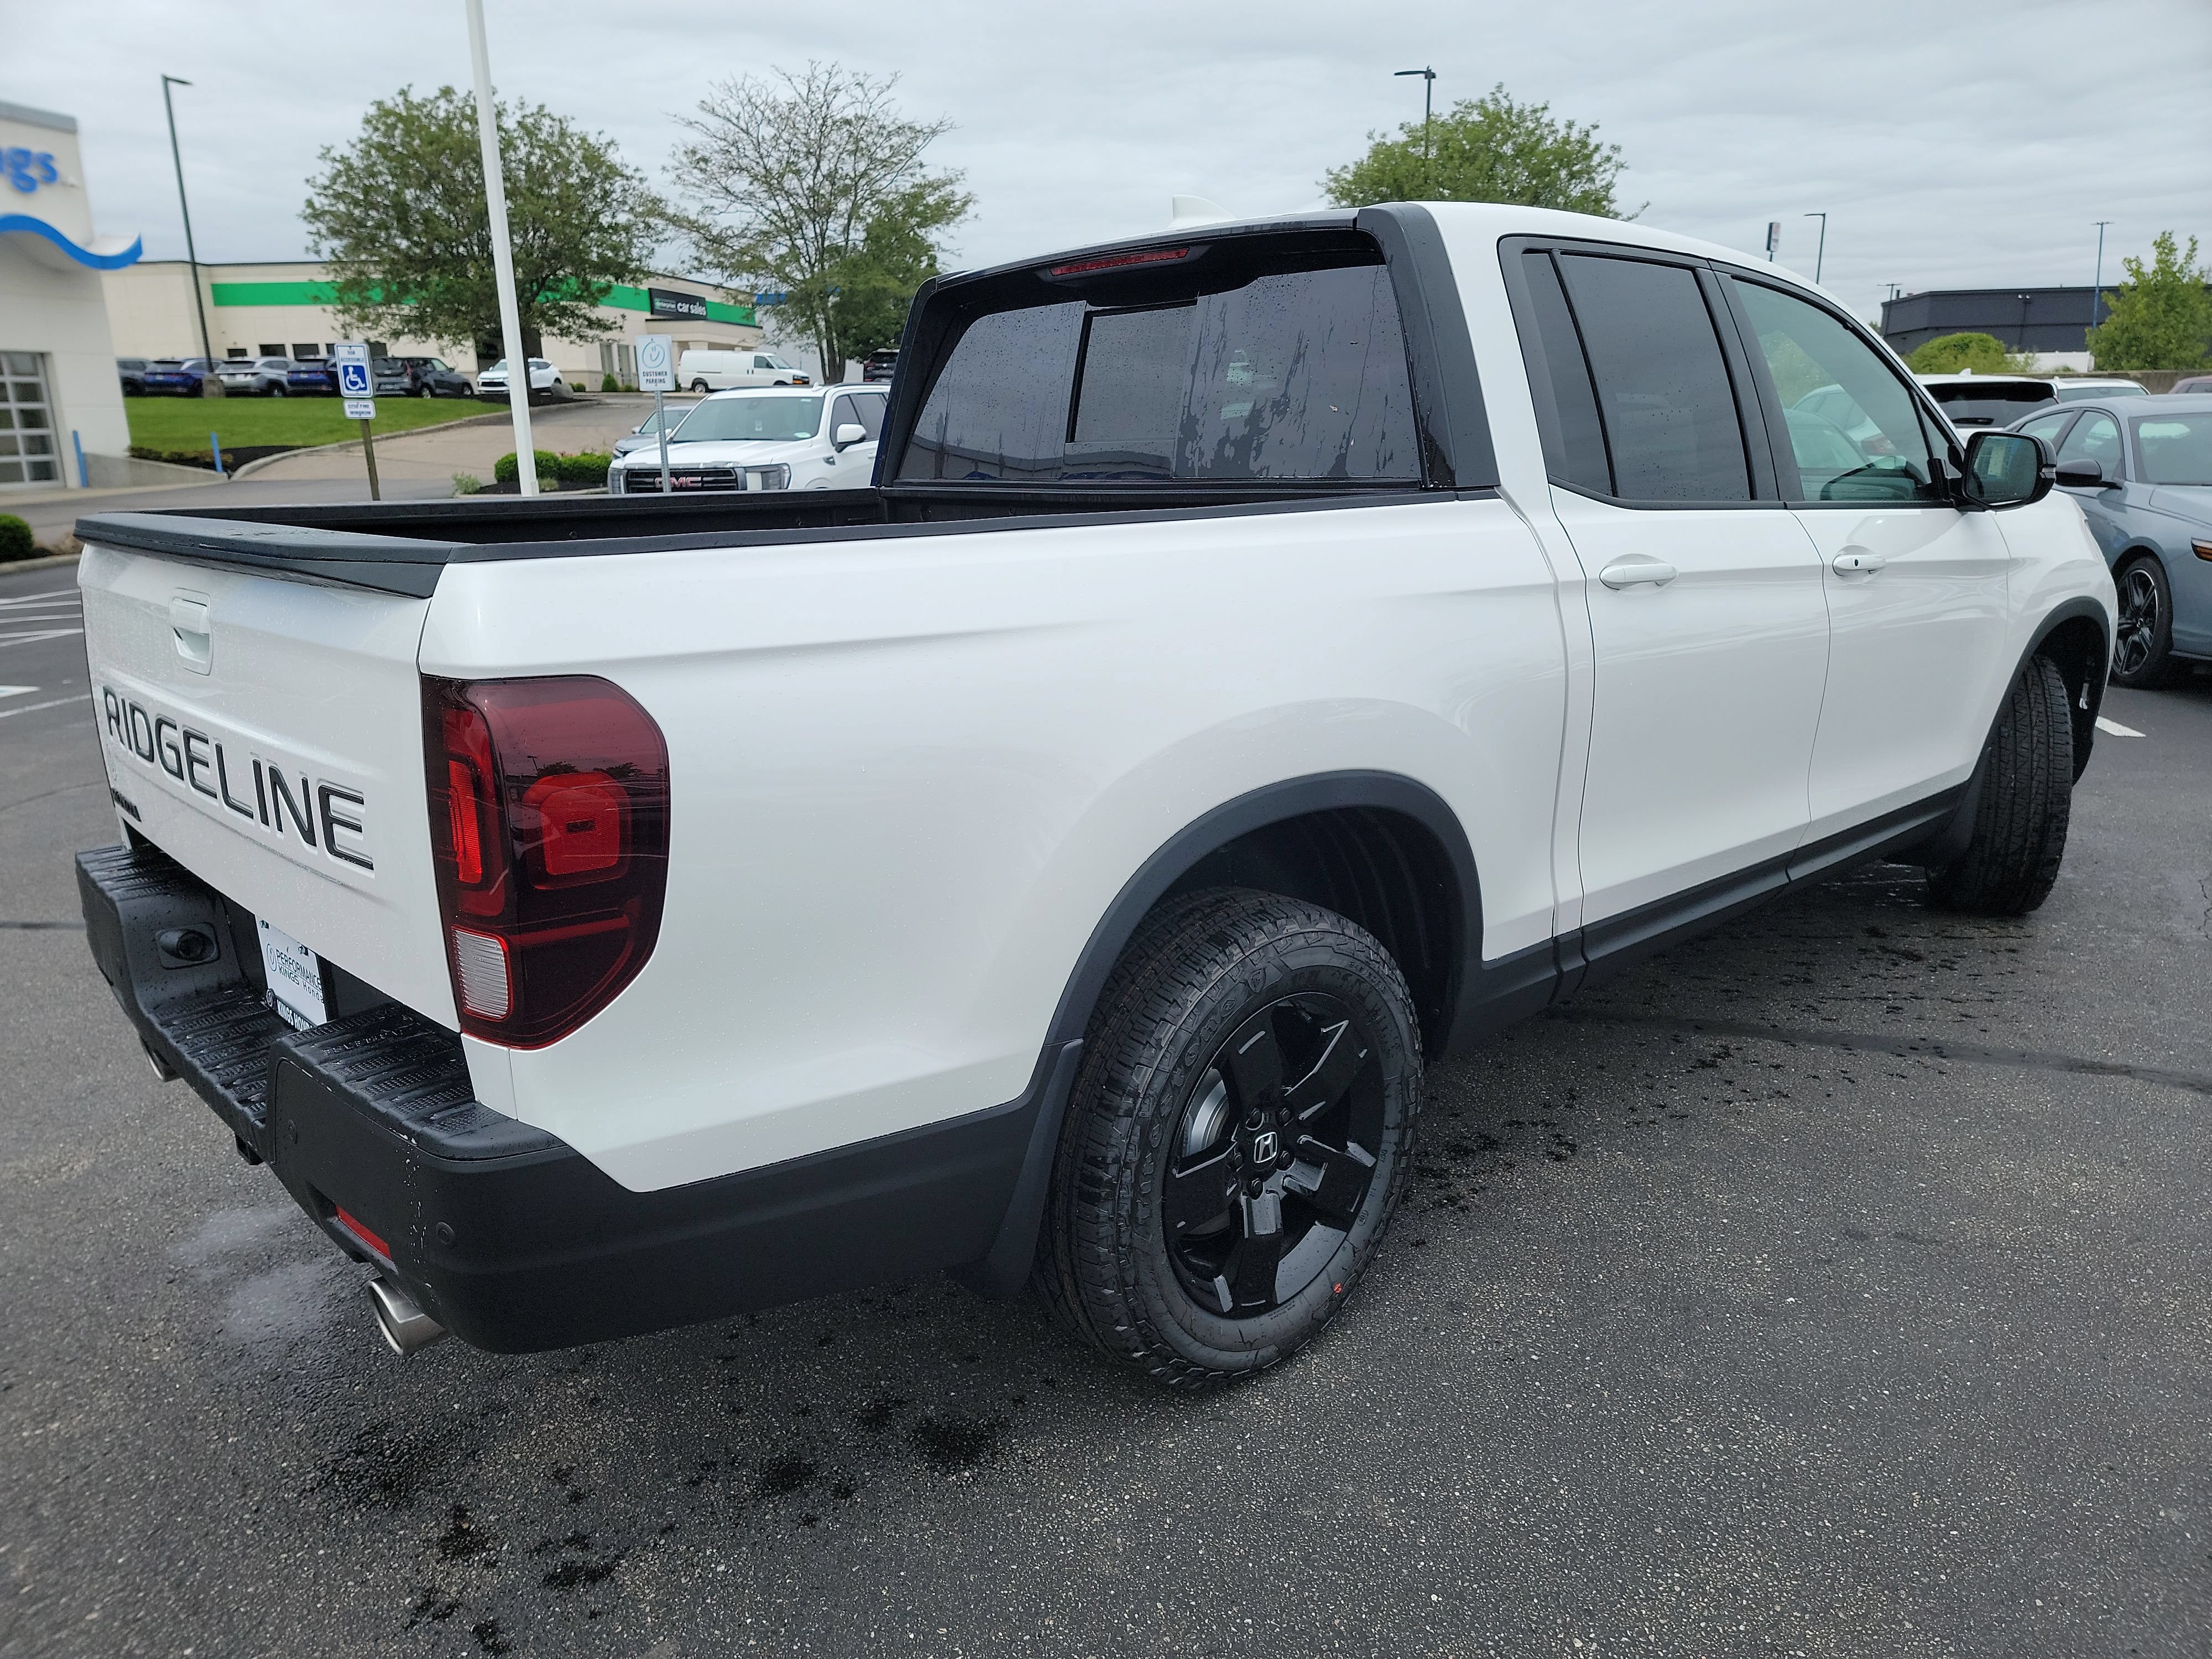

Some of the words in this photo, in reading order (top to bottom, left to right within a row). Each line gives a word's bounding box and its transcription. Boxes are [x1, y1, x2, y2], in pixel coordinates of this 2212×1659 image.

[0, 147, 58, 193] gs
[103, 685, 374, 870] RIDGELINE
[276, 948, 322, 991] PERFORMANCE
[278, 964, 300, 985] KINGS
[302, 980, 325, 1004] Honda
[276, 999, 294, 1026] KINGS
[294, 1012, 312, 1032] HOND
